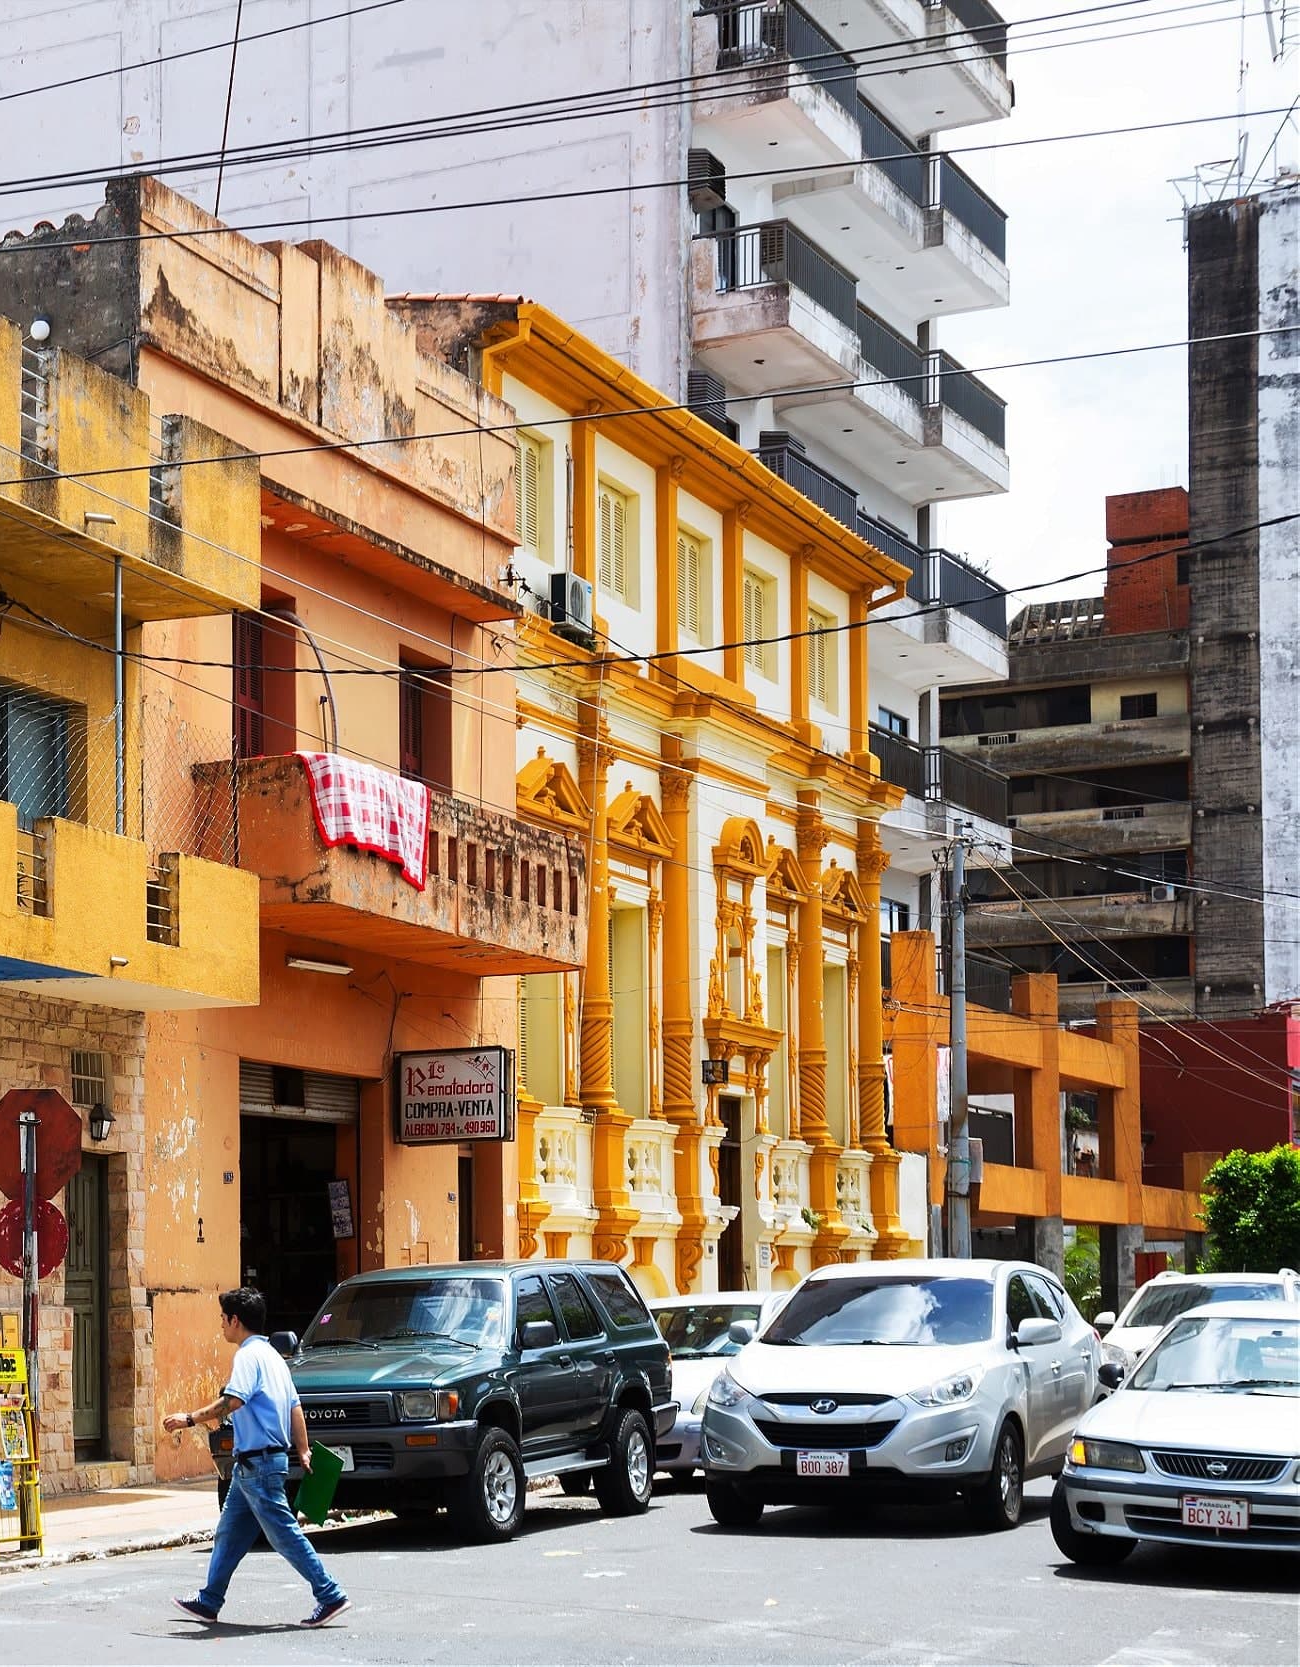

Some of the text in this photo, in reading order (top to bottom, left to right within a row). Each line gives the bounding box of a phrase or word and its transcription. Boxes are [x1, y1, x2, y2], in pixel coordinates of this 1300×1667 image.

[428, 1060, 445, 1080] La
[405, 1066, 494, 1097] Rematadora
[405, 1099, 495, 1119] COMPRA-VENTA
[404, 1122, 439, 1137] ALBERDI
[440, 1121, 456, 1135] 794
[304, 1410, 346, 1418] TOYOTA
[825, 1461, 844, 1473] 387
[1188, 1508, 1240, 1526] BCY 341
